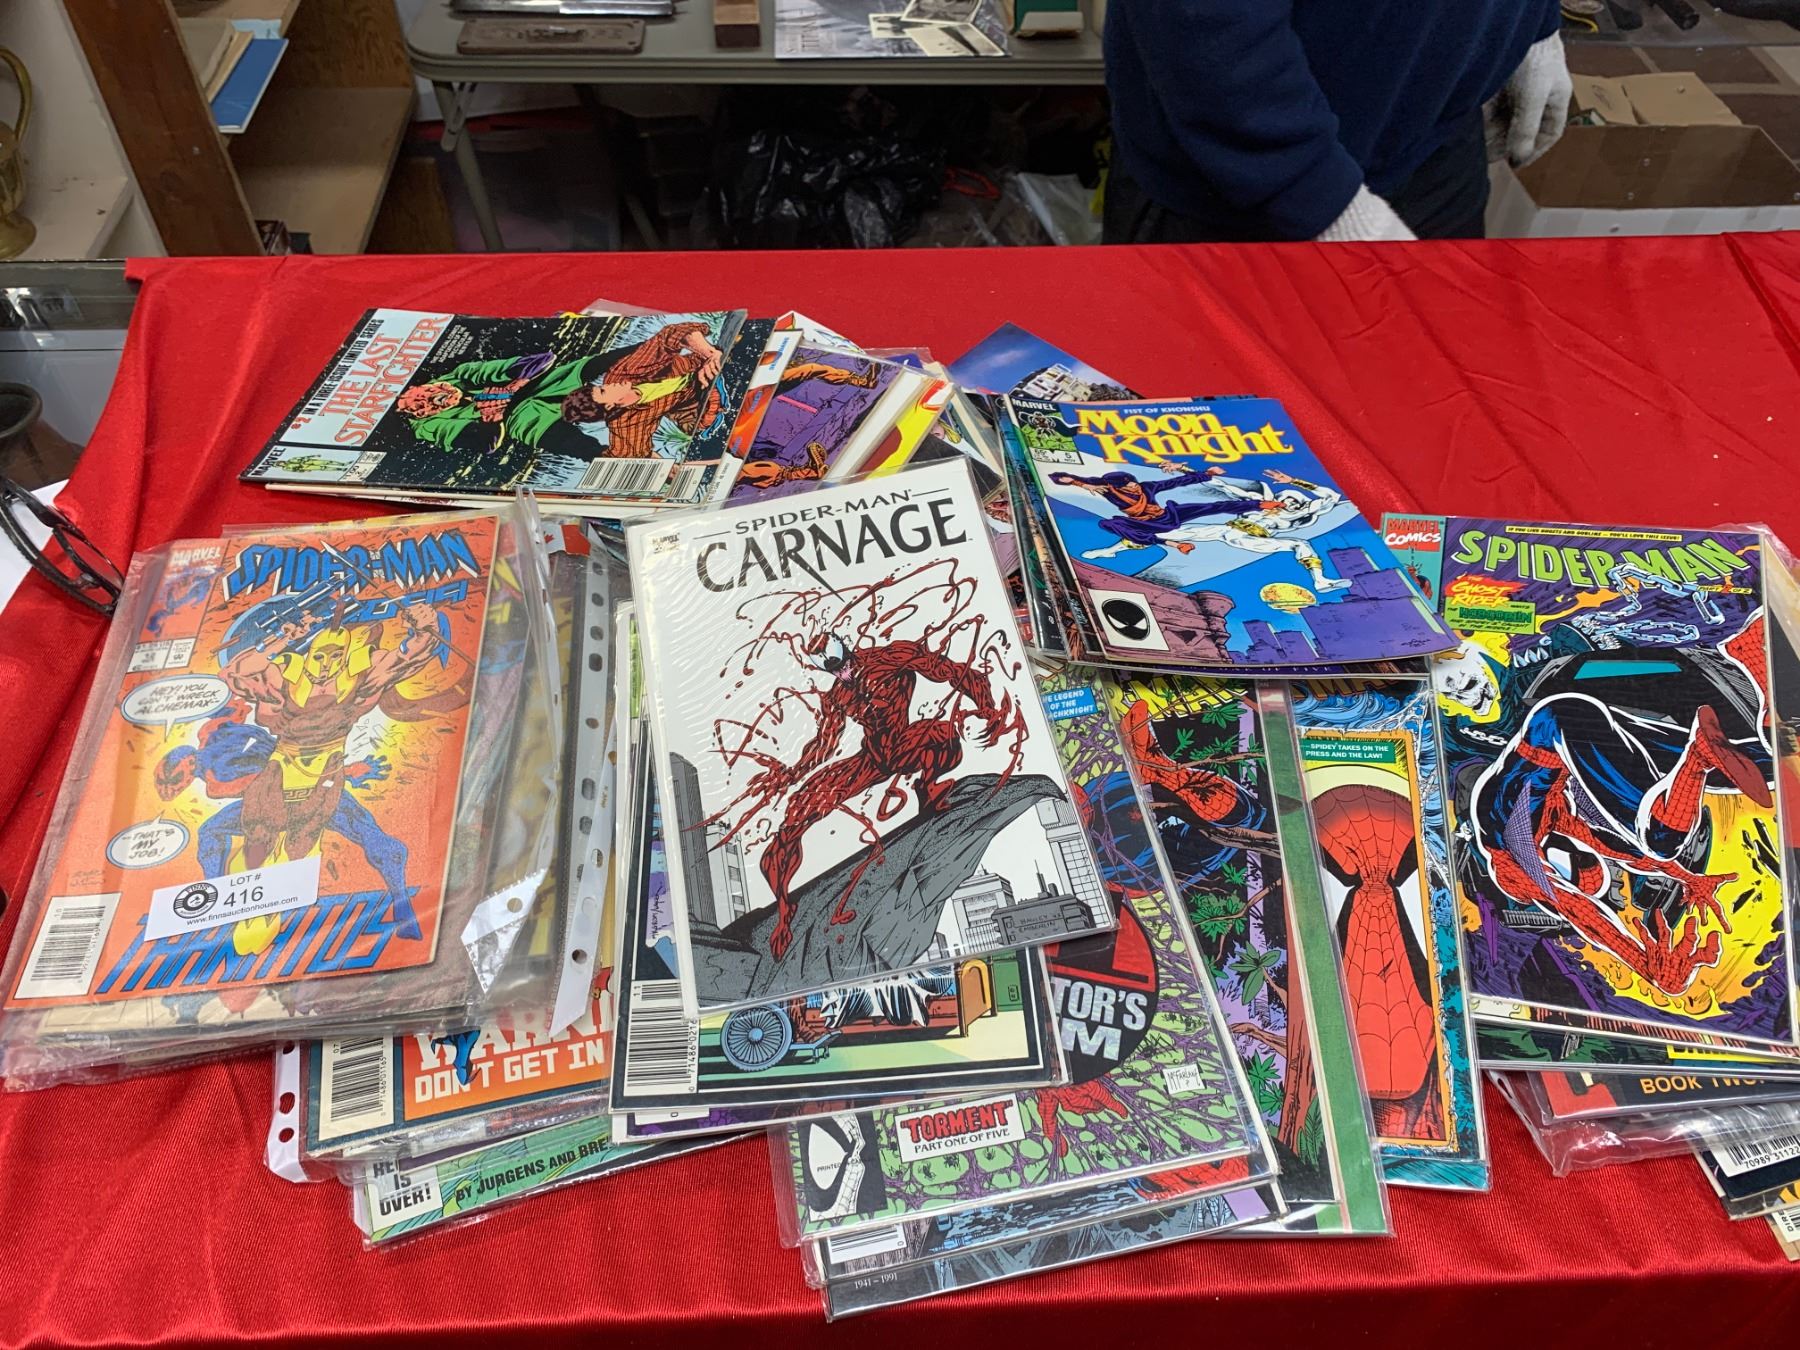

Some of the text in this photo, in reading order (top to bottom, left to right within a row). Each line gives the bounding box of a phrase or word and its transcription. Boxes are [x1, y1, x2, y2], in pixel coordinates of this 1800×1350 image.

[342, 340, 369, 371] LIMITED
[360, 318, 385, 341] SERIES
[319, 379, 372, 417] THE
[357, 333, 402, 379] LAST
[334, 314, 451, 445] STARFIGHTER
[1012, 398, 1056, 411] MARVEL
[1161, 405, 1211, 413] KHONSHU
[1075, 408, 1227, 436] Moon
[1093, 421, 1295, 464] Knight
[251, 446, 287, 478] MARVEL
[735, 488, 911, 535] SPIDER-MAN
[1387, 518, 1440, 531] MARVEL
[696, 497, 968, 600] CARNAGE
[1385, 531, 1442, 546] COMICS
[170, 546, 221, 567] MARVEL
[223, 529, 482, 601] SPIDER-MAN
[1451, 528, 1751, 588] SPIDERMAN
[1452, 581, 1514, 596] GHOST
[1451, 593, 1511, 608] RIDER
[176, 690, 221, 701] WRECK
[184, 683, 209, 693] YOU
[1054, 689, 1085, 701] LEGEND
[129, 847, 165, 860] JOB!
[131, 838, 160, 851] MY
[230, 872, 263, 887] LOT #
[223, 886, 264, 908] 416
[186, 895, 299, 927] www.finnsauctionhouse.com
[415, 1038, 605, 1104] DON'T GET IN
[688, 1045, 696, 1074] 71486
[1640, 1076, 1703, 1094] BOOK
[900, 1098, 1014, 1144] "TORMENT"
[914, 1128, 1010, 1154] PART ONE OF FIVE
[456, 1136, 612, 1201] BY JURGENS AND BRE
[1744, 1154, 1771, 1169] 70989
[394, 1172, 411, 1190] IS
[380, 1183, 431, 1216] OVER!
[1777, 1208, 1795, 1232] DIRE
[855, 1278, 871, 1289] 1941
[881, 1272, 898, 1284] 1991
